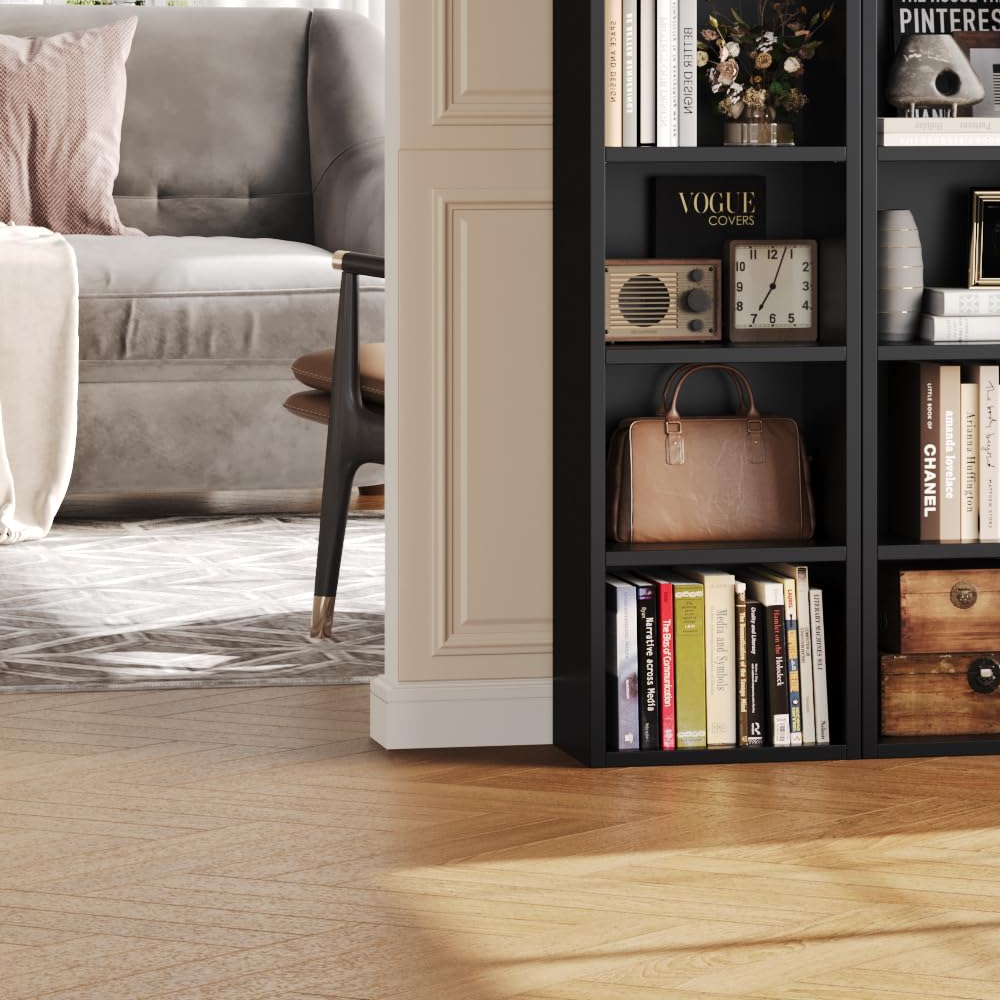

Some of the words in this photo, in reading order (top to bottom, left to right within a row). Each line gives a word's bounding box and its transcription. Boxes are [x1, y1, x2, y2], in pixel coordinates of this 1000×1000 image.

[679, 192, 755, 214] VOGUE
[708, 215, 755, 226] COVERS
[767, 250, 778, 260] 12
[736, 262, 746, 272] 10
[802, 262, 809, 272] 2
[736, 282, 743, 292] 9
[802, 281, 809, 291] 3
[736, 302, 743, 311] 8
[802, 301, 809, 311] 4
[751, 314, 758, 324] 7
[769, 313, 776, 323] 6
[788, 313, 795, 323] 5
[946, 410, 956, 452] amanda
[967, 411, 976, 452] Arianna
[924, 444, 937, 517] CHANEL
[946, 455, 956, 499] lovelace
[965, 456, 976, 513] Huffington
[662, 619, 671, 633] The
[716, 610, 728, 634] Media
[773, 609, 782, 633] Hamlet
[645, 617, 654, 656] Narrative
[774, 635, 781, 643] on
[663, 648, 672, 656] of
[716, 637, 728, 653] and
[714, 656, 728, 692] Symbols
[776, 656, 784, 687] Holodeck
[663, 656, 672, 707] Communication
[647, 688, 656, 712] Media
